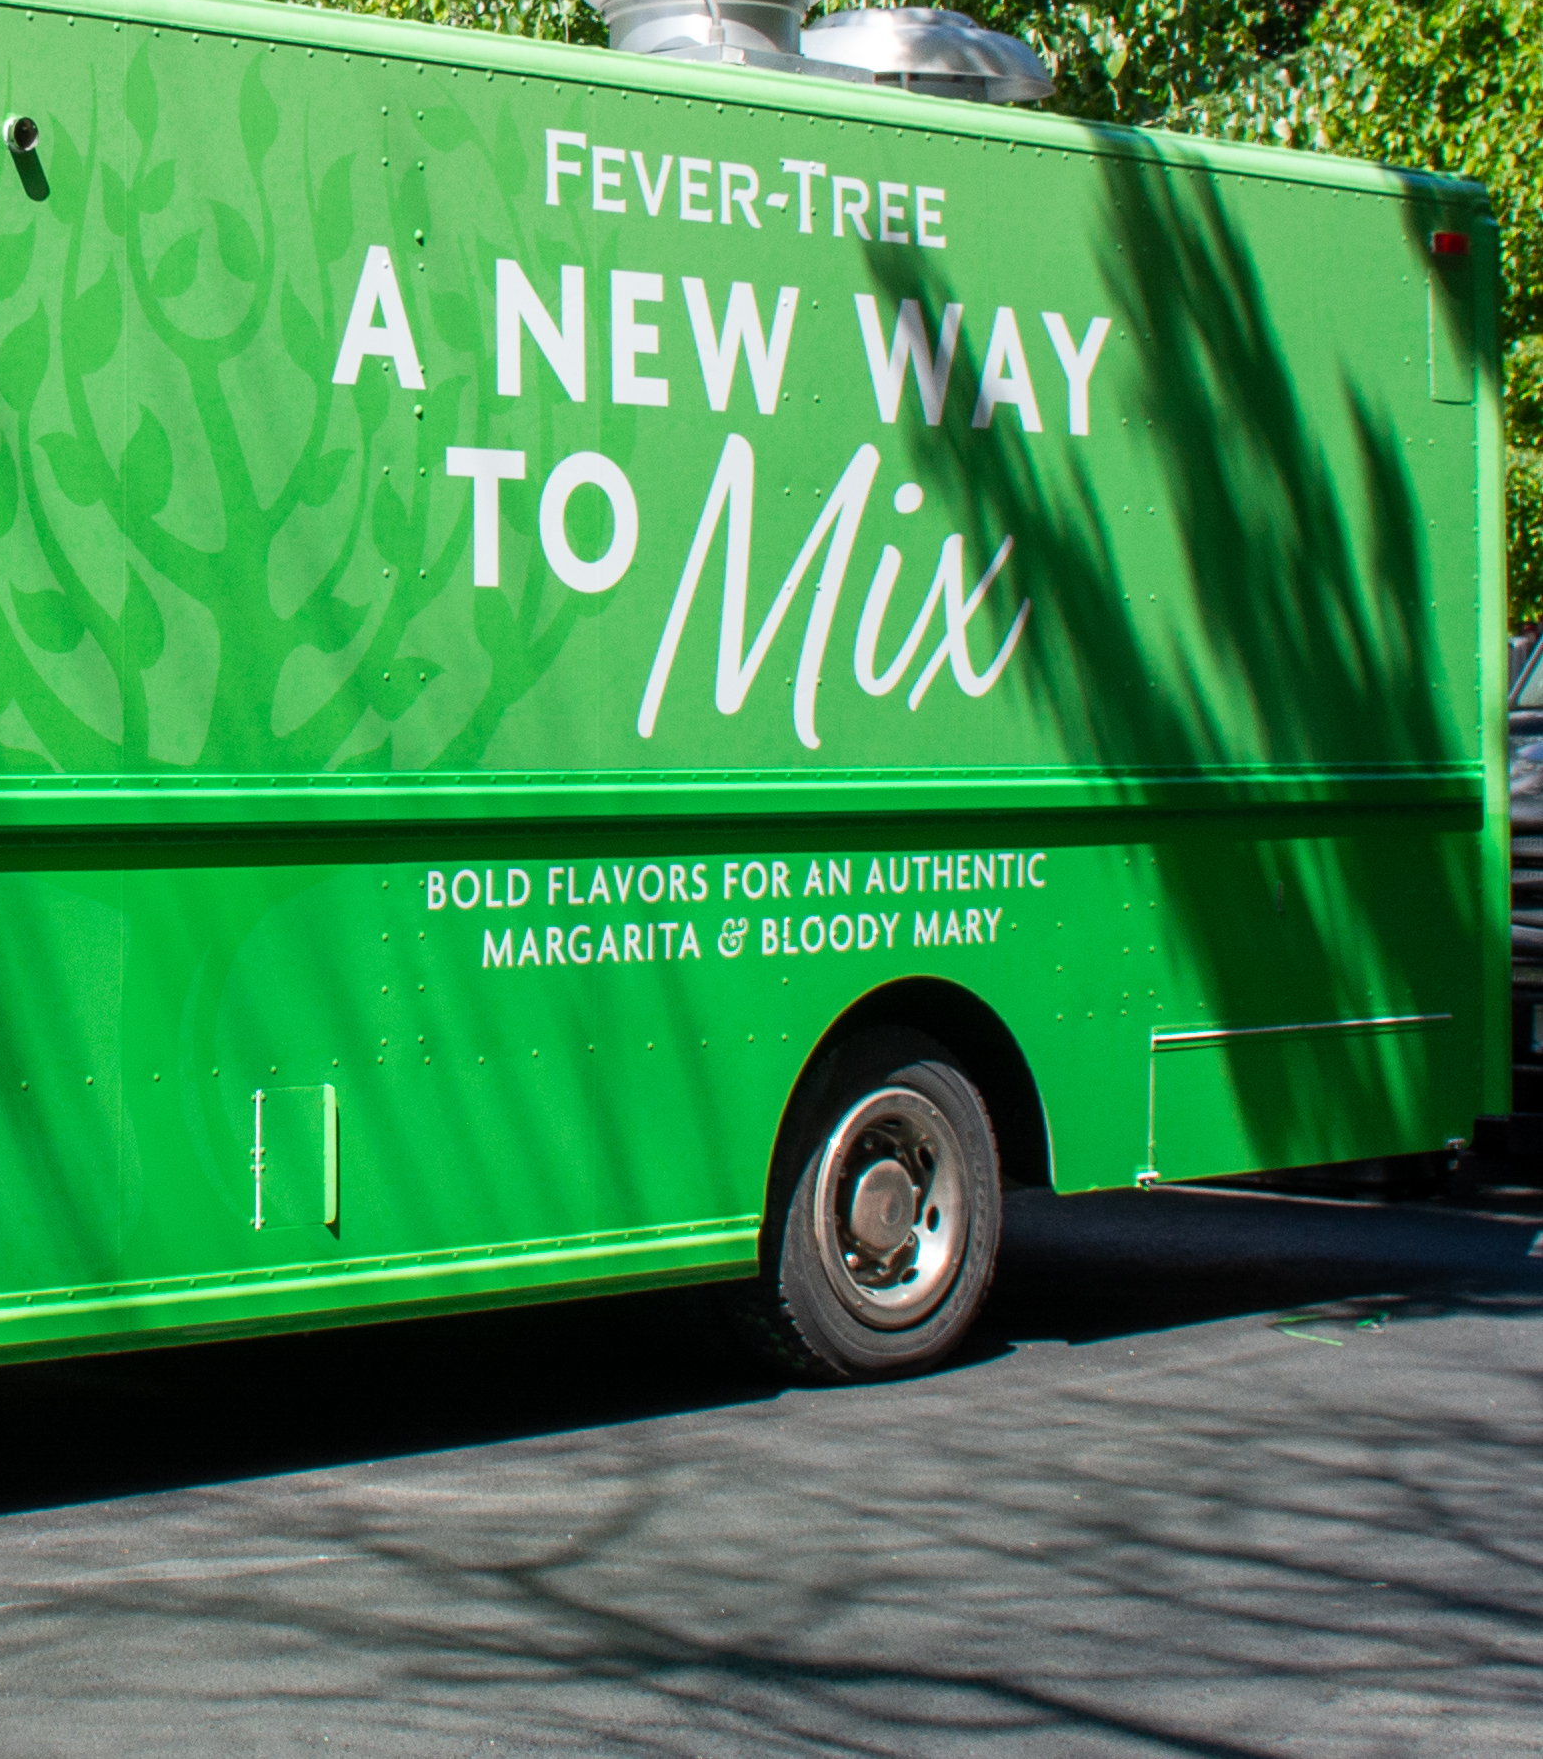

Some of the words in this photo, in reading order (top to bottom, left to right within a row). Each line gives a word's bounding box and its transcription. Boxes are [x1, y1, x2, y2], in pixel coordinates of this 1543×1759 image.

[331, 244, 426, 390] A
[495, 258, 800, 416] NEW
[854, 292, 1112, 437] WAY
[445, 446, 639, 594] TO
[636, 432, 1031, 750] Mix
[426, 868, 531, 911] BOLD
[547, 863, 709, 906] FLAVORS
[723, 859, 791, 900] FOR
[801, 858, 852, 898] AN
[864, 852, 1047, 894] AUTHENTIC
[481, 921, 701, 969] MARGARITA
[717, 917, 749, 958] &
[760, 912, 901, 956] BLOODY
[912, 906, 1003, 948] MARY
